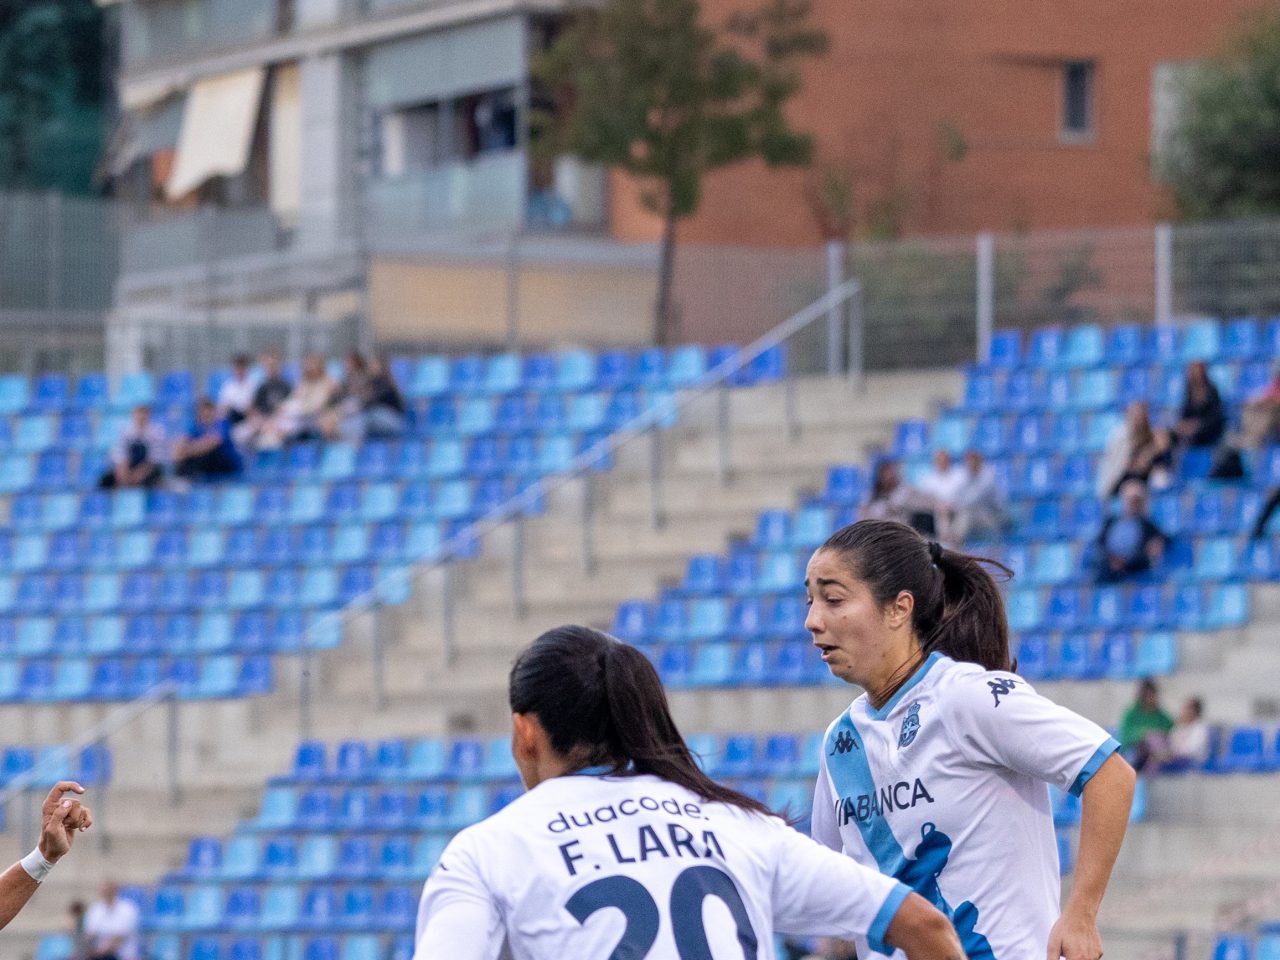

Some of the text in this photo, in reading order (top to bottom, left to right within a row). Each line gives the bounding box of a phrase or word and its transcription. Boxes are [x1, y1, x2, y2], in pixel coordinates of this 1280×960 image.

[834, 778, 935, 827] ABANCA
[558, 823, 726, 876] F. LARA
